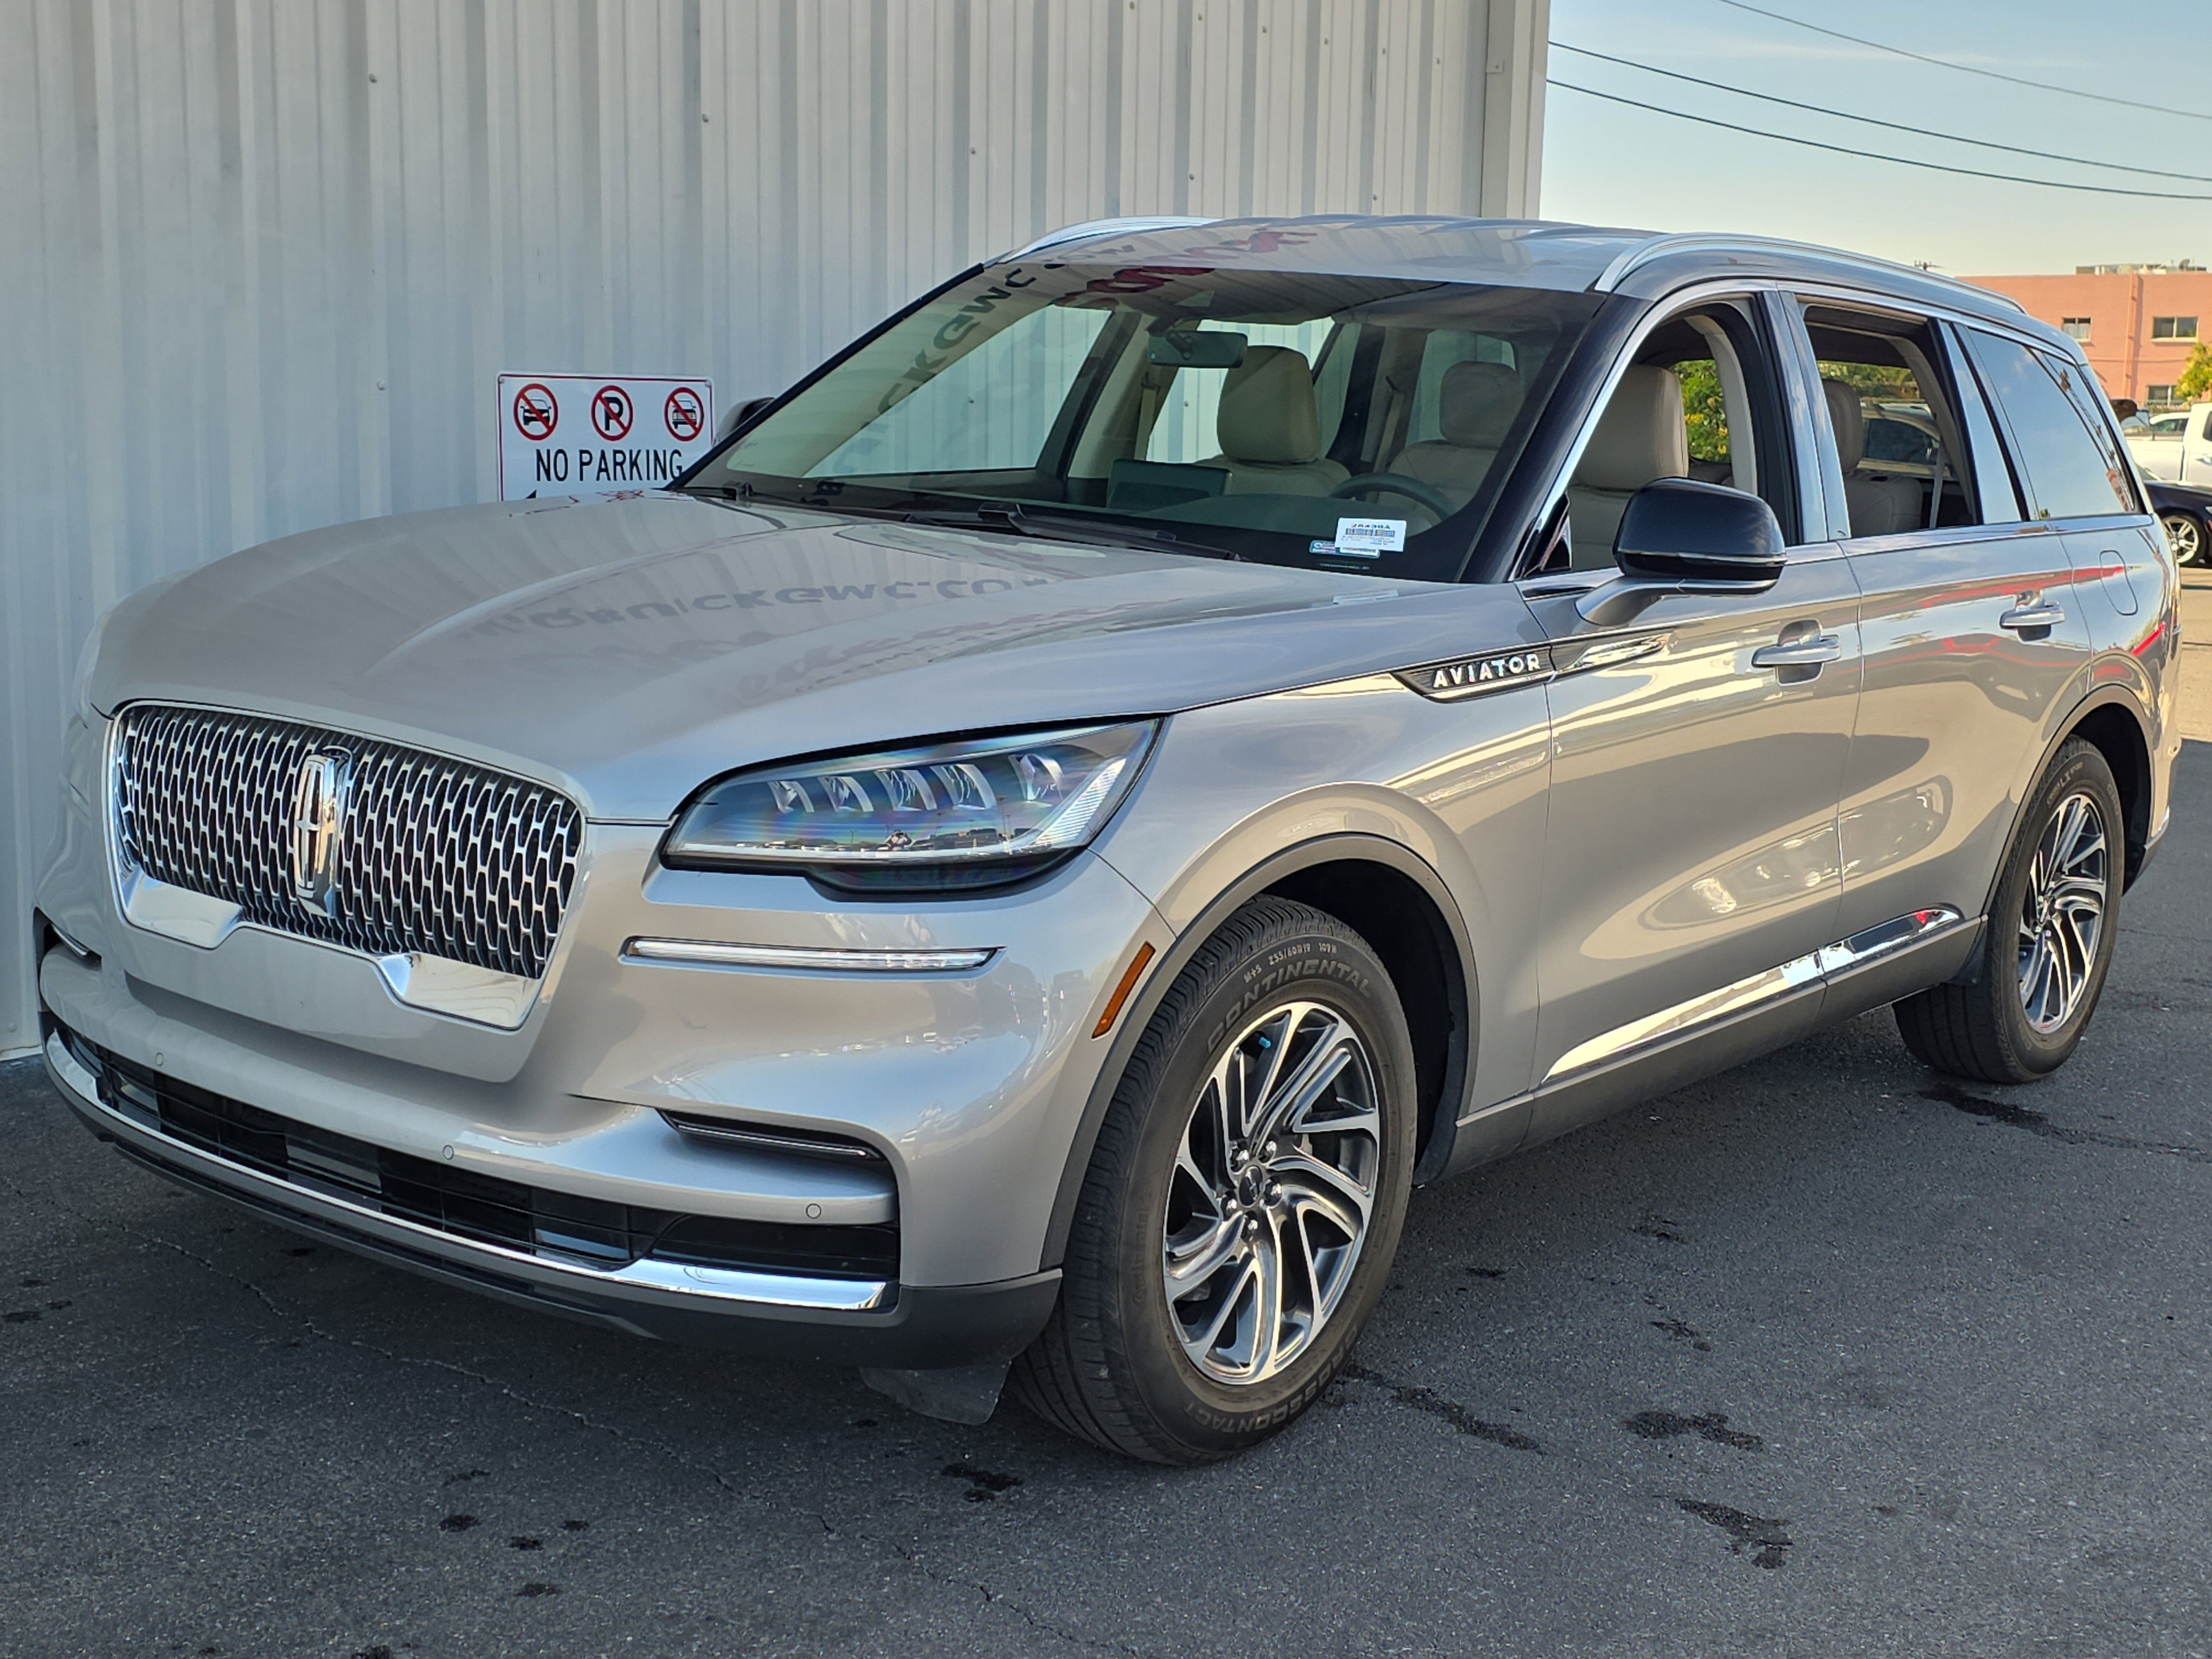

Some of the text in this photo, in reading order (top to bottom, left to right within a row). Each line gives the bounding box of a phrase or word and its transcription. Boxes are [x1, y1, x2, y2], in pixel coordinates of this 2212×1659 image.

[535, 448, 683, 481] NO PARKING
[1432, 653, 1540, 688] AVIATOR
[1207, 959, 1372, 1053] CONTINENTAL
